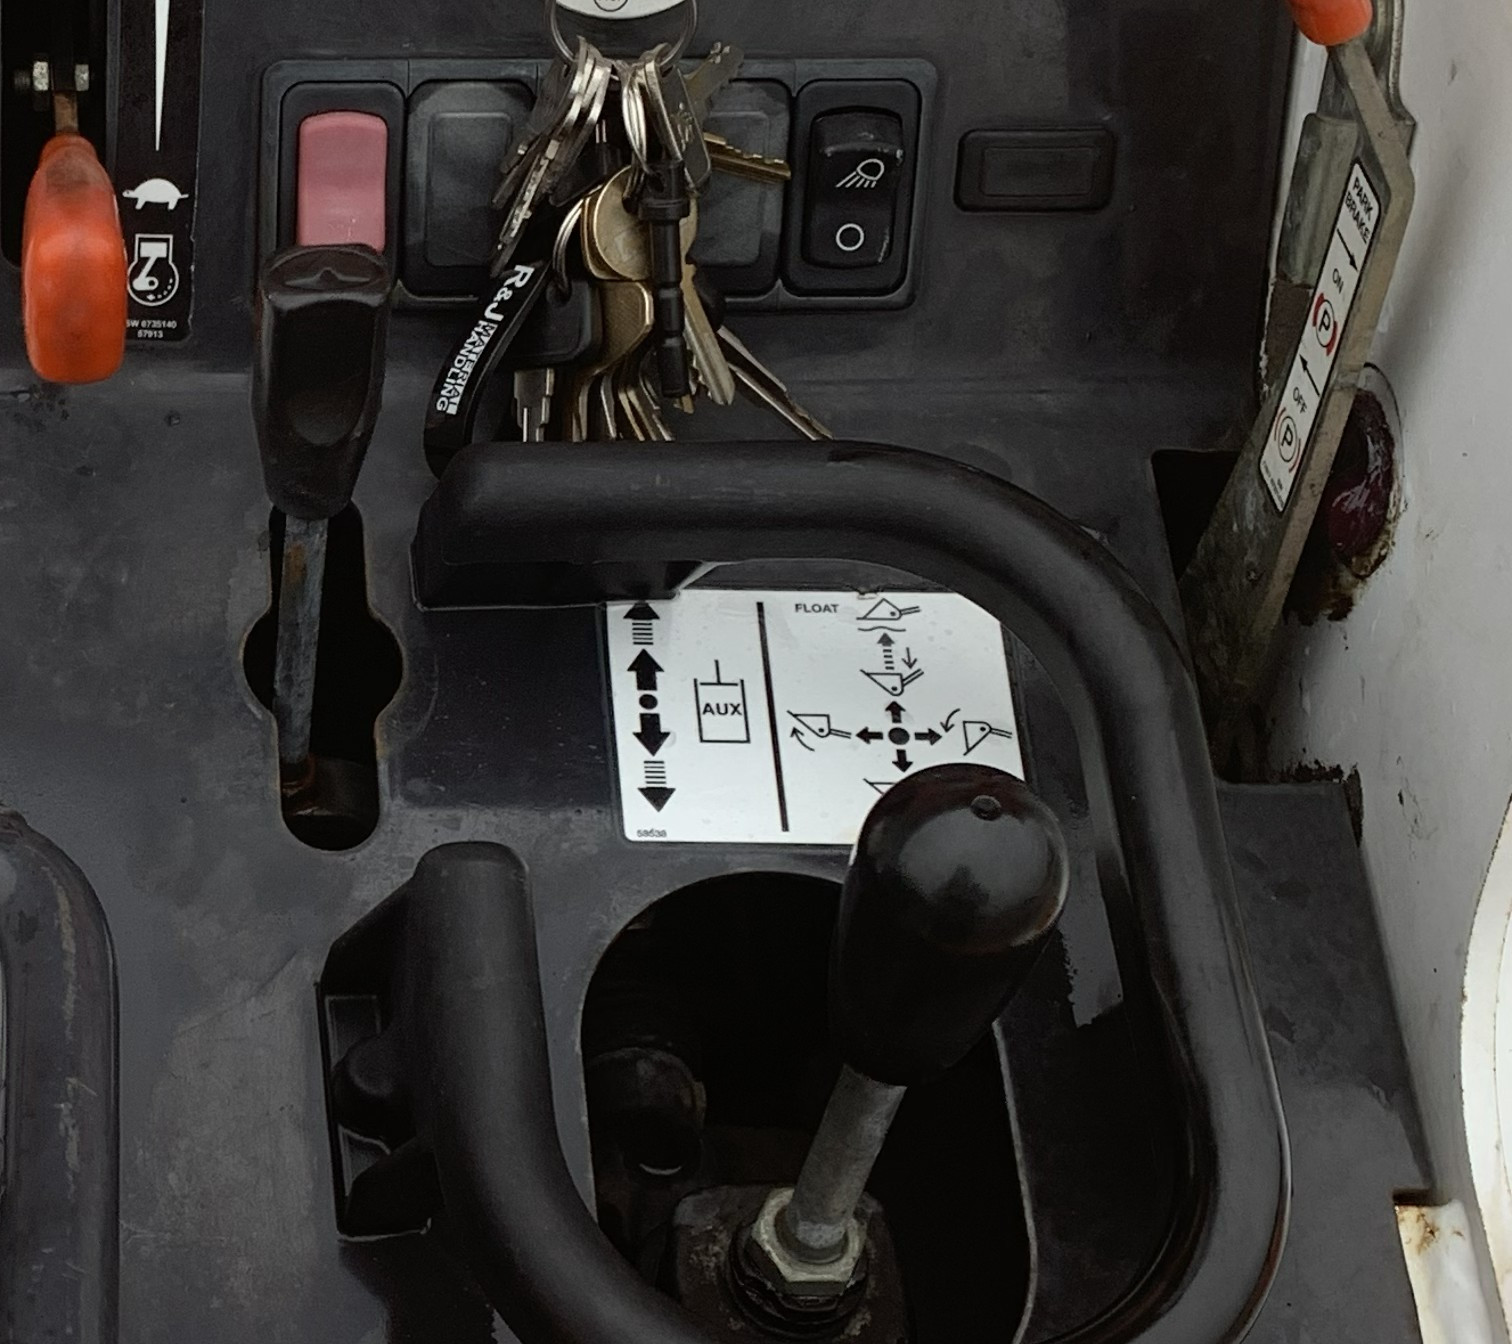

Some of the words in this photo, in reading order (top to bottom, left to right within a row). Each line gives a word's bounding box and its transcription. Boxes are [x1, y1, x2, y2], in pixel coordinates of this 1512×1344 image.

[1353, 176, 1373, 221] PARK
[1345, 191, 1370, 244] BRAKE
[484, 264, 535, 322] R&J
[1332, 268, 1344, 295] ON
[436, 320, 484, 412] HANDLING
[1292, 387, 1307, 414] OFF
[794, 602, 839, 614] FLOAT
[702, 702, 742, 716] AUX
